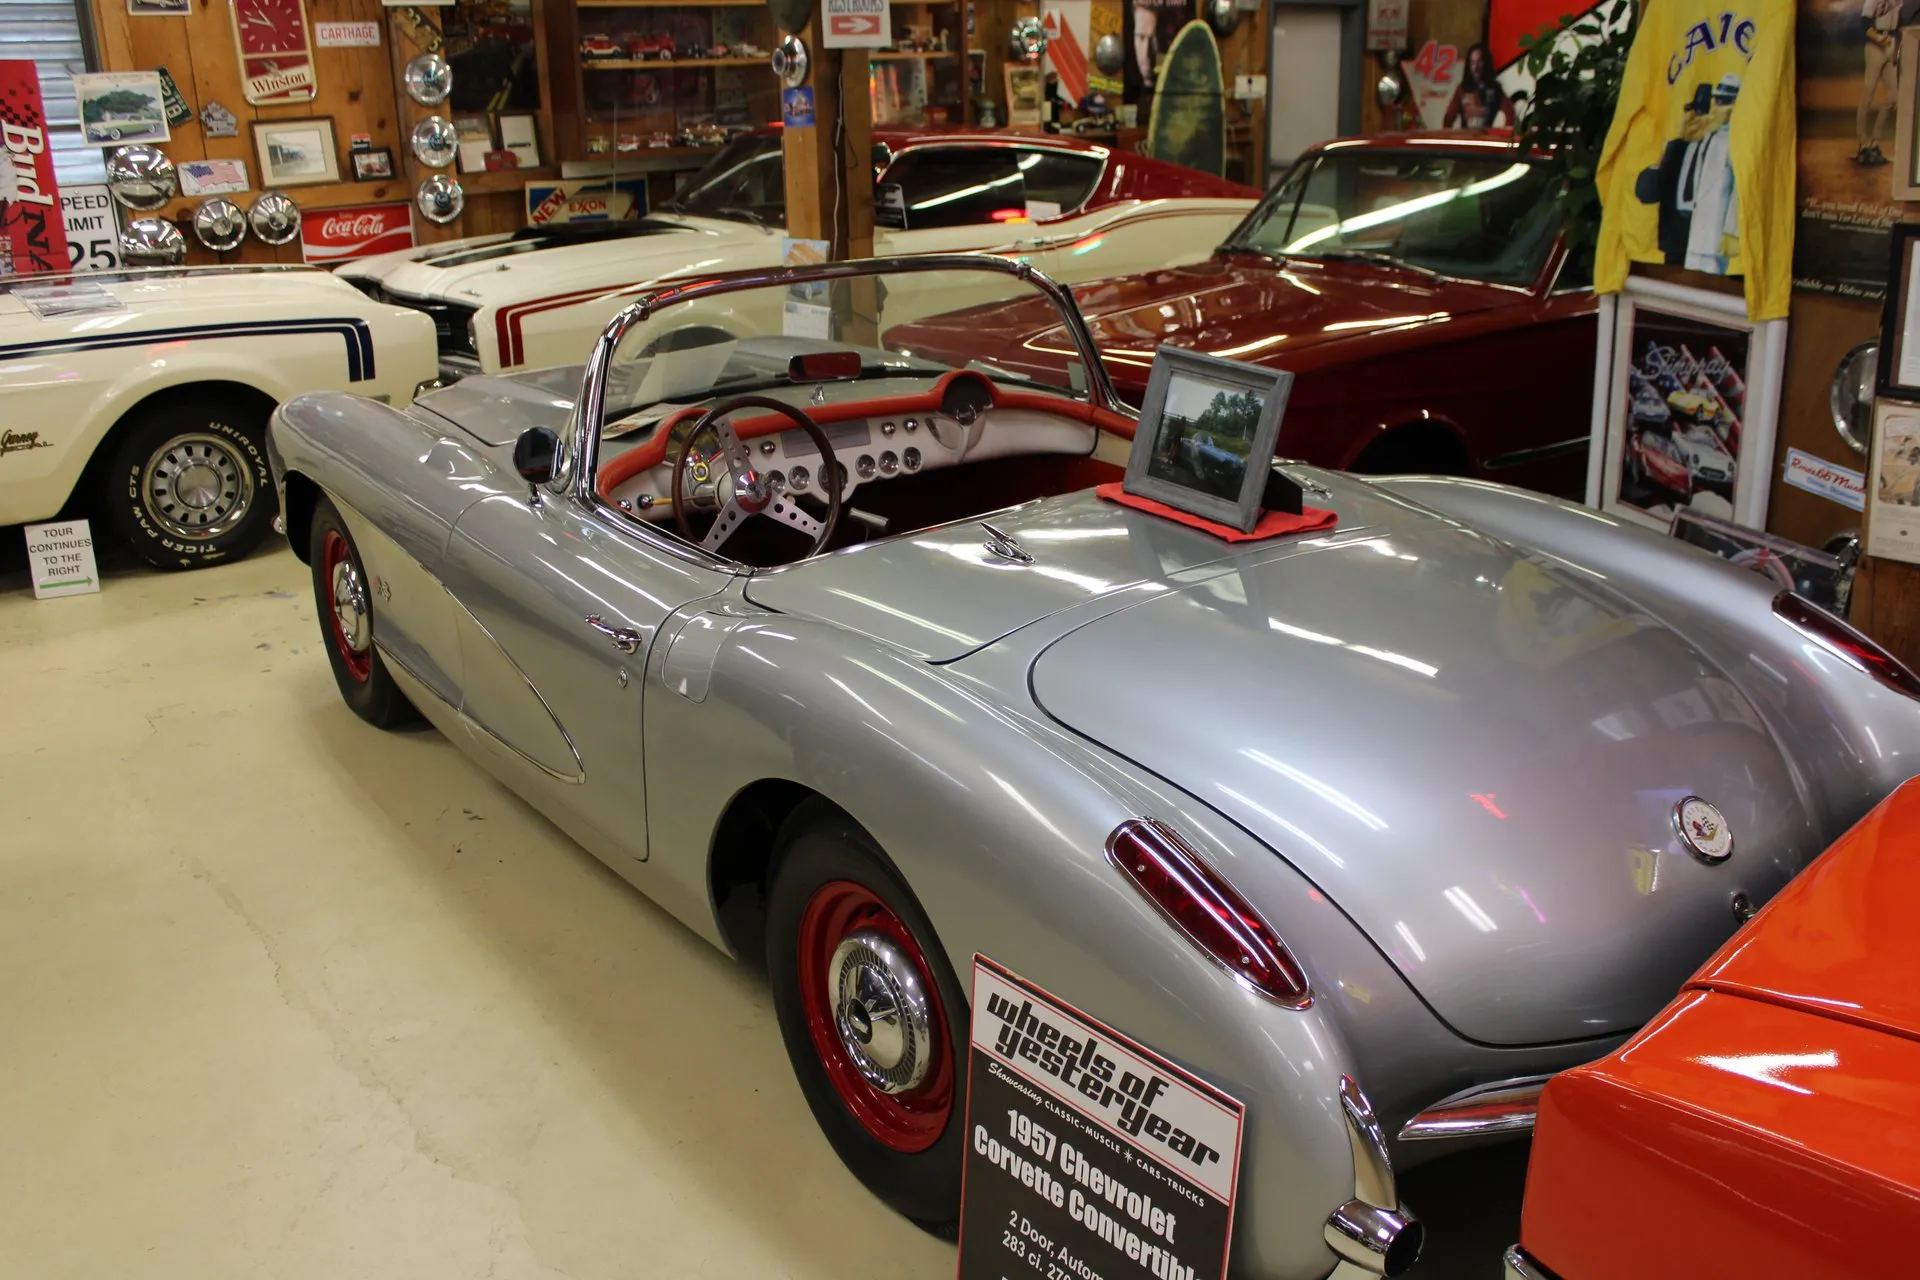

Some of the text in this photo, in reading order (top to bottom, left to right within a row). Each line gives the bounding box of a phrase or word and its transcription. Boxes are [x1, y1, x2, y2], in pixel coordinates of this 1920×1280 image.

[320, 26, 376, 41] CARTHAGE
[1414, 40, 1458, 82] 42
[252, 71, 307, 95] Winston
[1, 119, 54, 207] Bud
[60, 194, 109, 211] PEED
[531, 187, 567, 225] NEW
[568, 199, 607, 215] EXXON
[64, 216, 104, 232] IMIT
[322, 213, 385, 240] Coca-Cola
[209, 421, 269, 487] UNIROYAL
[29, 538, 92, 554] CONTINUES
[42, 527, 74, 538] TOUR
[43, 553, 83, 566] TO THE
[48, 565, 81, 577] RIGHT
[986, 992, 1170, 1108] wheels of
[994, 1023, 1220, 1168] yesteryear
[988, 1062, 1043, 1106] Showcasing
[1136, 1158, 1205, 1208] CARS-TRUCKS
[1007, 1109, 1176, 1246] 1957 Chevrolet
[974, 1124, 1204, 1280] Corvette Convertibl
[1002, 1229, 1026, 1258] 283
[1028, 1252, 1043, 1273] ci.
[1009, 1209, 1018, 1229] 2
[1020, 1216, 1055, 1258] Door,
